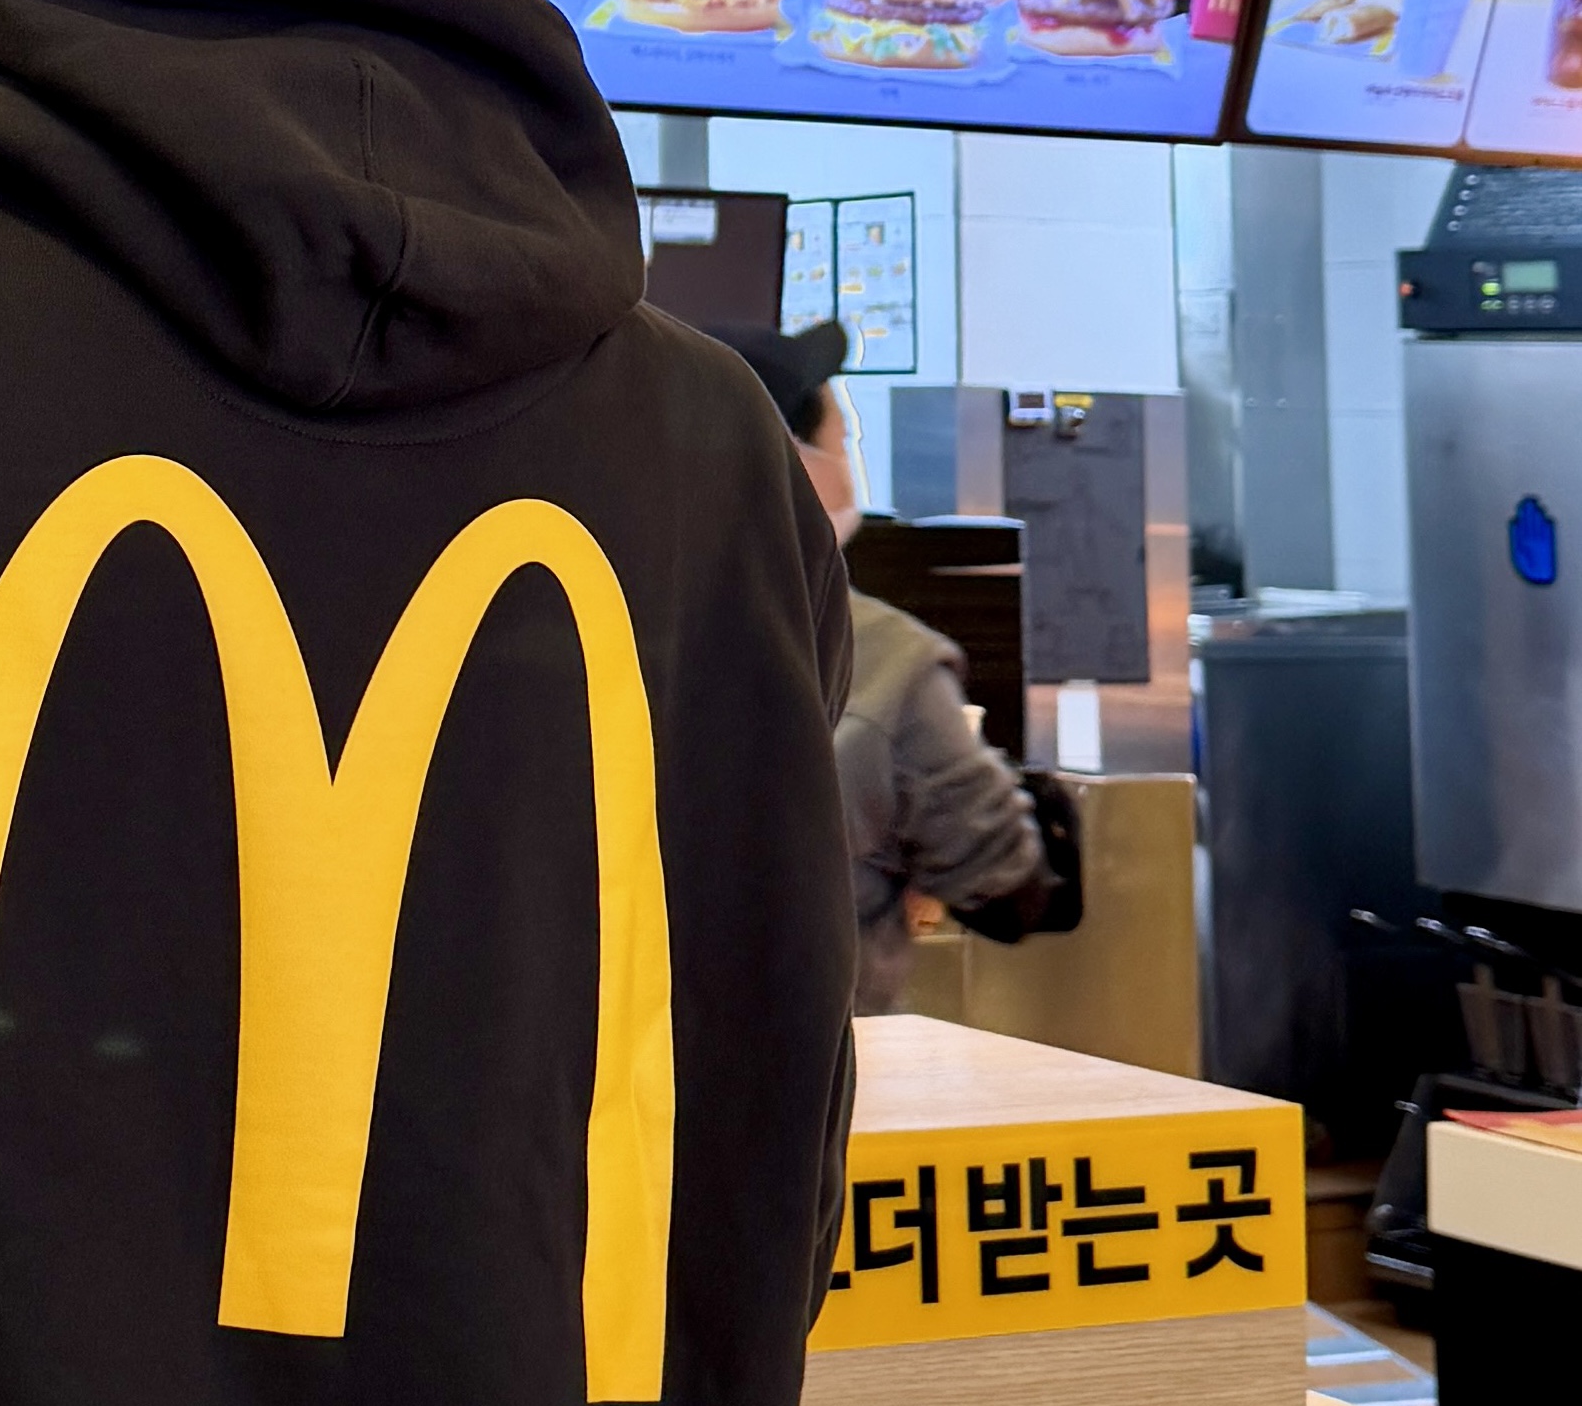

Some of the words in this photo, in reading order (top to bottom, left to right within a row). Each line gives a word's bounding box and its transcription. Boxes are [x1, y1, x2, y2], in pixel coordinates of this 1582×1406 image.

[830, 1164, 940, 1304] 더
[966, 1156, 1160, 1297] 받는
[1175, 1146, 1272, 1279] 곳
